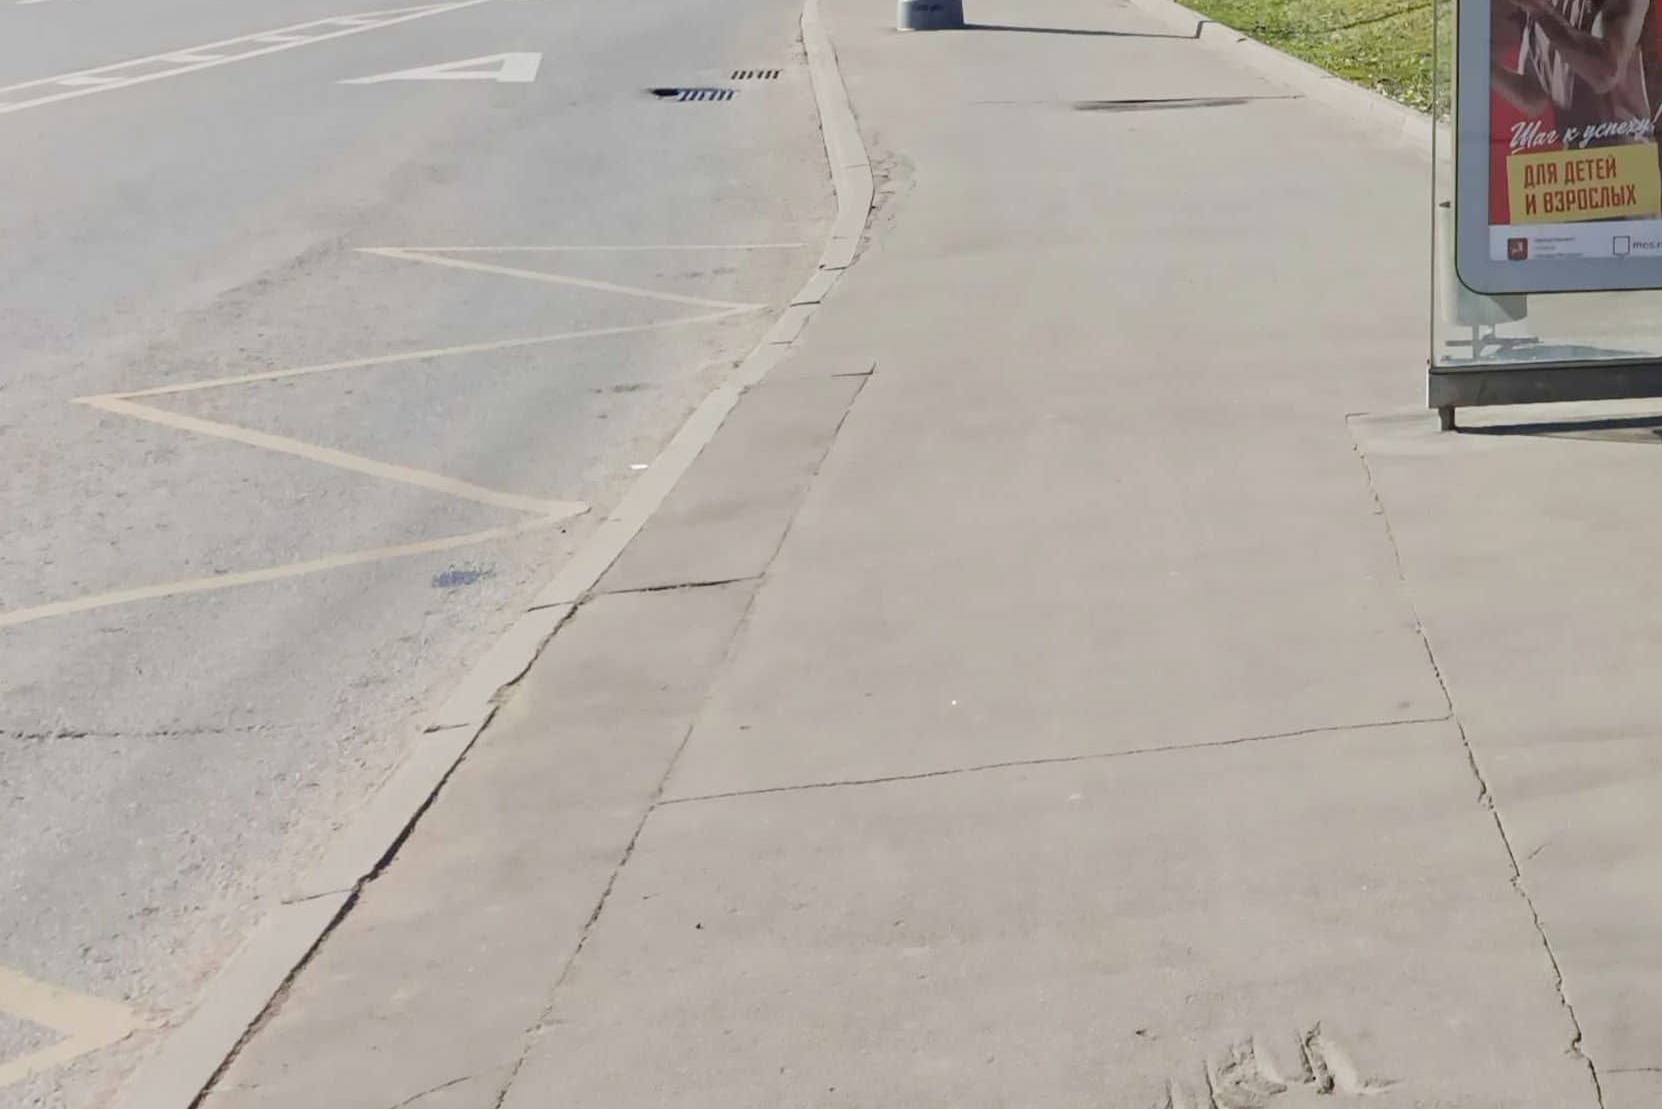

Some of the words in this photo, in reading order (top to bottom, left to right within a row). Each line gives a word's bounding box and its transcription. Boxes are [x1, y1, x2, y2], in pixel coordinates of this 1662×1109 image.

[1510, 120, 1559, 155] Шаг
[1524, 163, 1558, 189] ДЛЯ
[1564, 154, 1617, 184] ДЕТЕЙ
[1525, 193, 1537, 216] И
[1543, 184, 1637, 213] ВЗРОСЛЫХ
